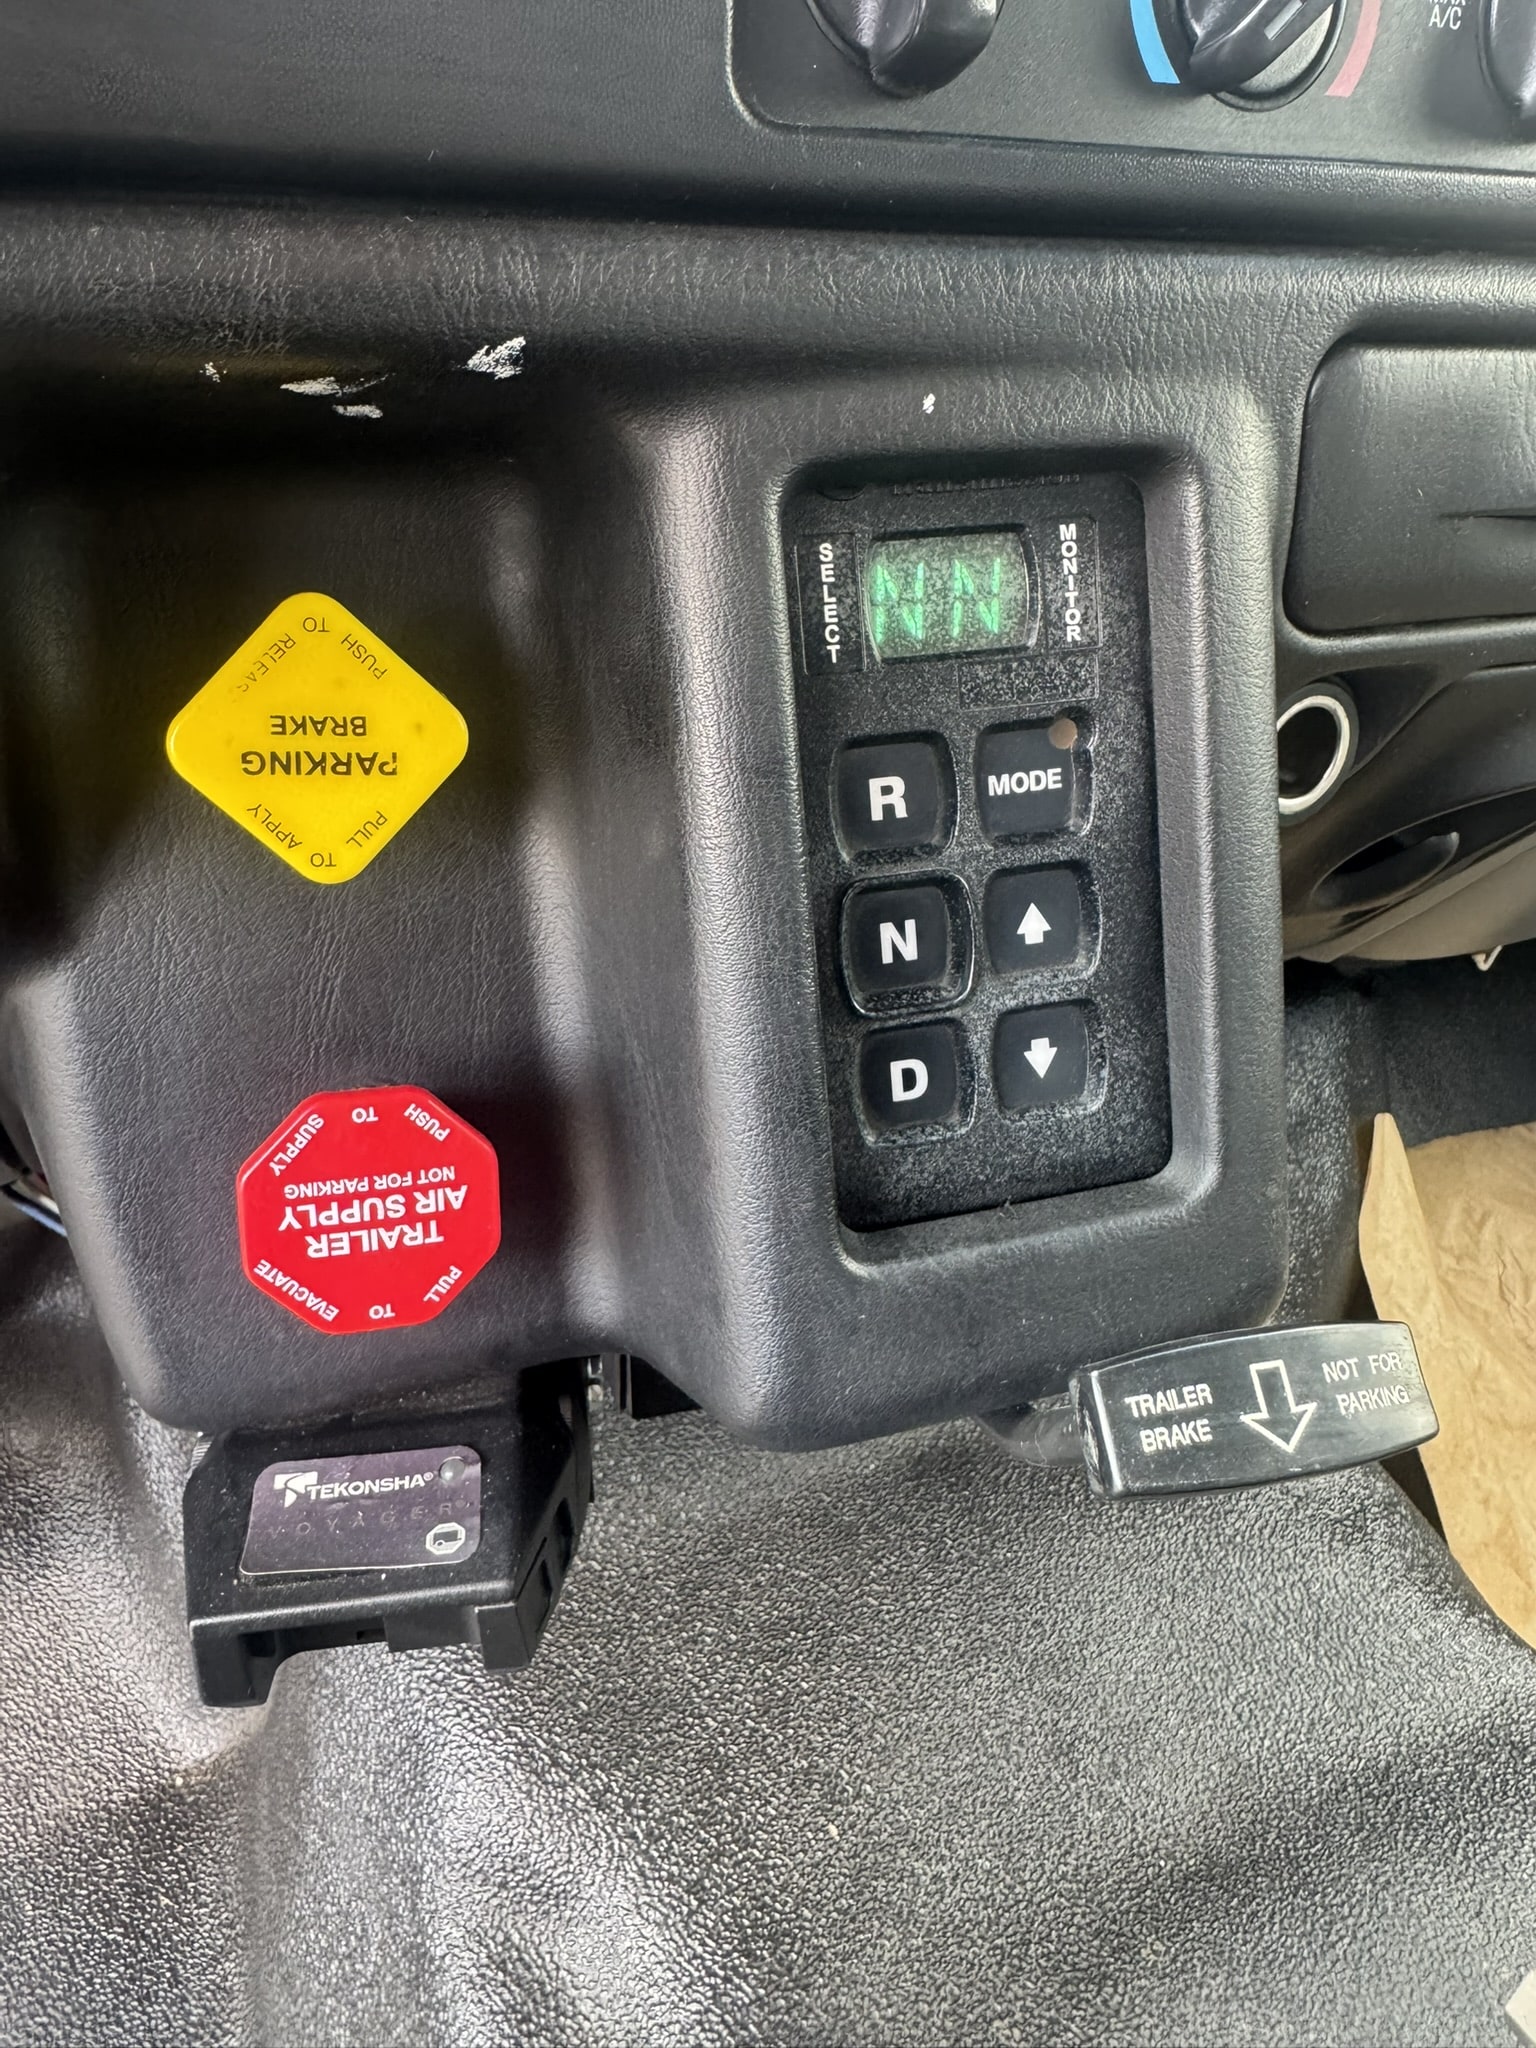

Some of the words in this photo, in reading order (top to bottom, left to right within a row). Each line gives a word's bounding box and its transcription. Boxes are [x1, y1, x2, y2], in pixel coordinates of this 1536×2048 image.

[1428, 4, 1462, 30] A/C
[1059, 523, 1081, 642] MONITOR
[819, 543, 840, 664] SELECT
[303, 617, 330, 633] TO
[232, 633, 296, 702] RELEAS
[340, 633, 388, 680] PUSH
[270, 715, 367, 737] BRAKE
[241, 751, 398, 776] PARKING
[868, 775, 908, 821] R
[987, 768, 1062, 796] MODE
[246, 803, 302, 850] APPLY
[346, 810, 388, 848] PULL
[310, 853, 337, 868] TO
[879, 919, 918, 964] N
[889, 1058, 928, 1102] D
[351, 1106, 378, 1123] TO
[403, 1103, 450, 1142] PUSH
[268, 1114, 324, 1176] SUPPLY
[284, 1176, 369, 1199] PARKING
[373, 1171, 413, 1188] FOR
[417, 1166, 455, 1184] NOT
[278, 1194, 406, 1231] SUPPLY
[413, 1185, 468, 1215] AIR
[304, 1220, 444, 1258] TRAILER
[253, 1259, 340, 1322] EVACUATE
[423, 1265, 463, 1303] PULL
[369, 1303, 395, 1319] TO
[1321, 1358, 1360, 1384] NOT
[1368, 1351, 1401, 1374] FOR
[1124, 1383, 1213, 1419] TRAILER
[1335, 1385, 1409, 1416] PARKING
[1139, 1419, 1213, 1453] BRAKE
